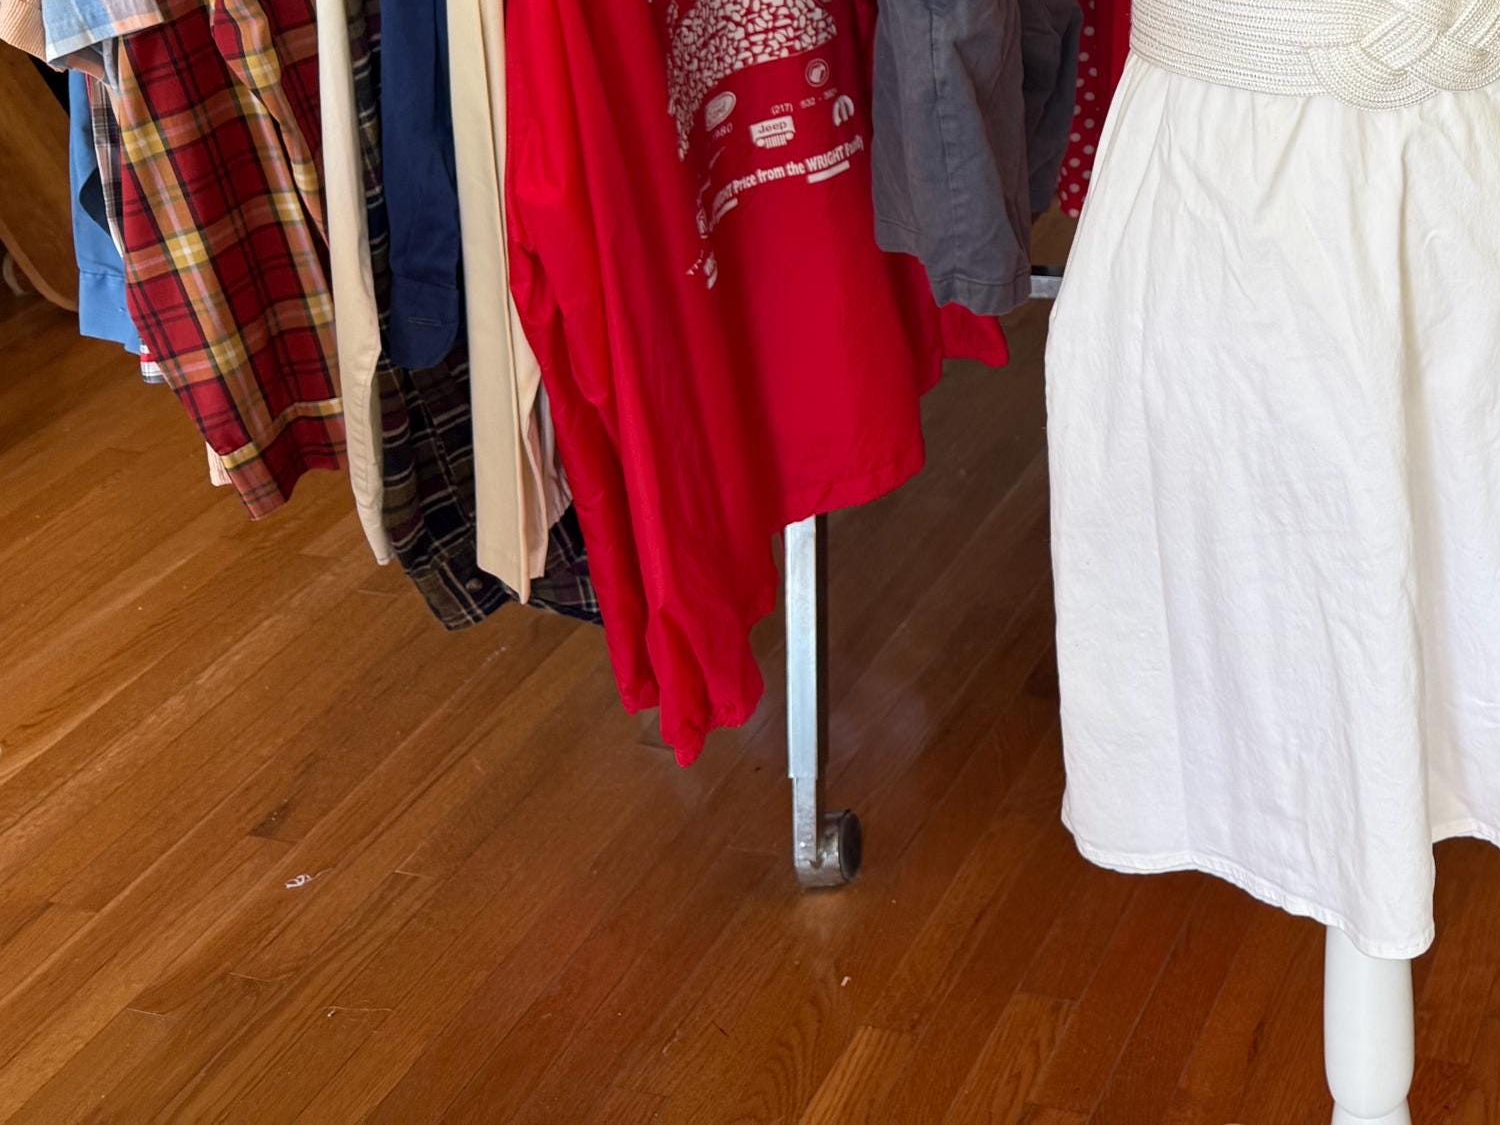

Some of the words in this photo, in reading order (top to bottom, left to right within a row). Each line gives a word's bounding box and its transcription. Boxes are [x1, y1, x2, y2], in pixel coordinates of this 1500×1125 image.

[758, 120, 788, 134] Jeep
[733, 174, 758, 194] Price
[757, 165, 786, 184] from
[786, 160, 806, 176] the
[806, 145, 845, 173] WRIGHT
